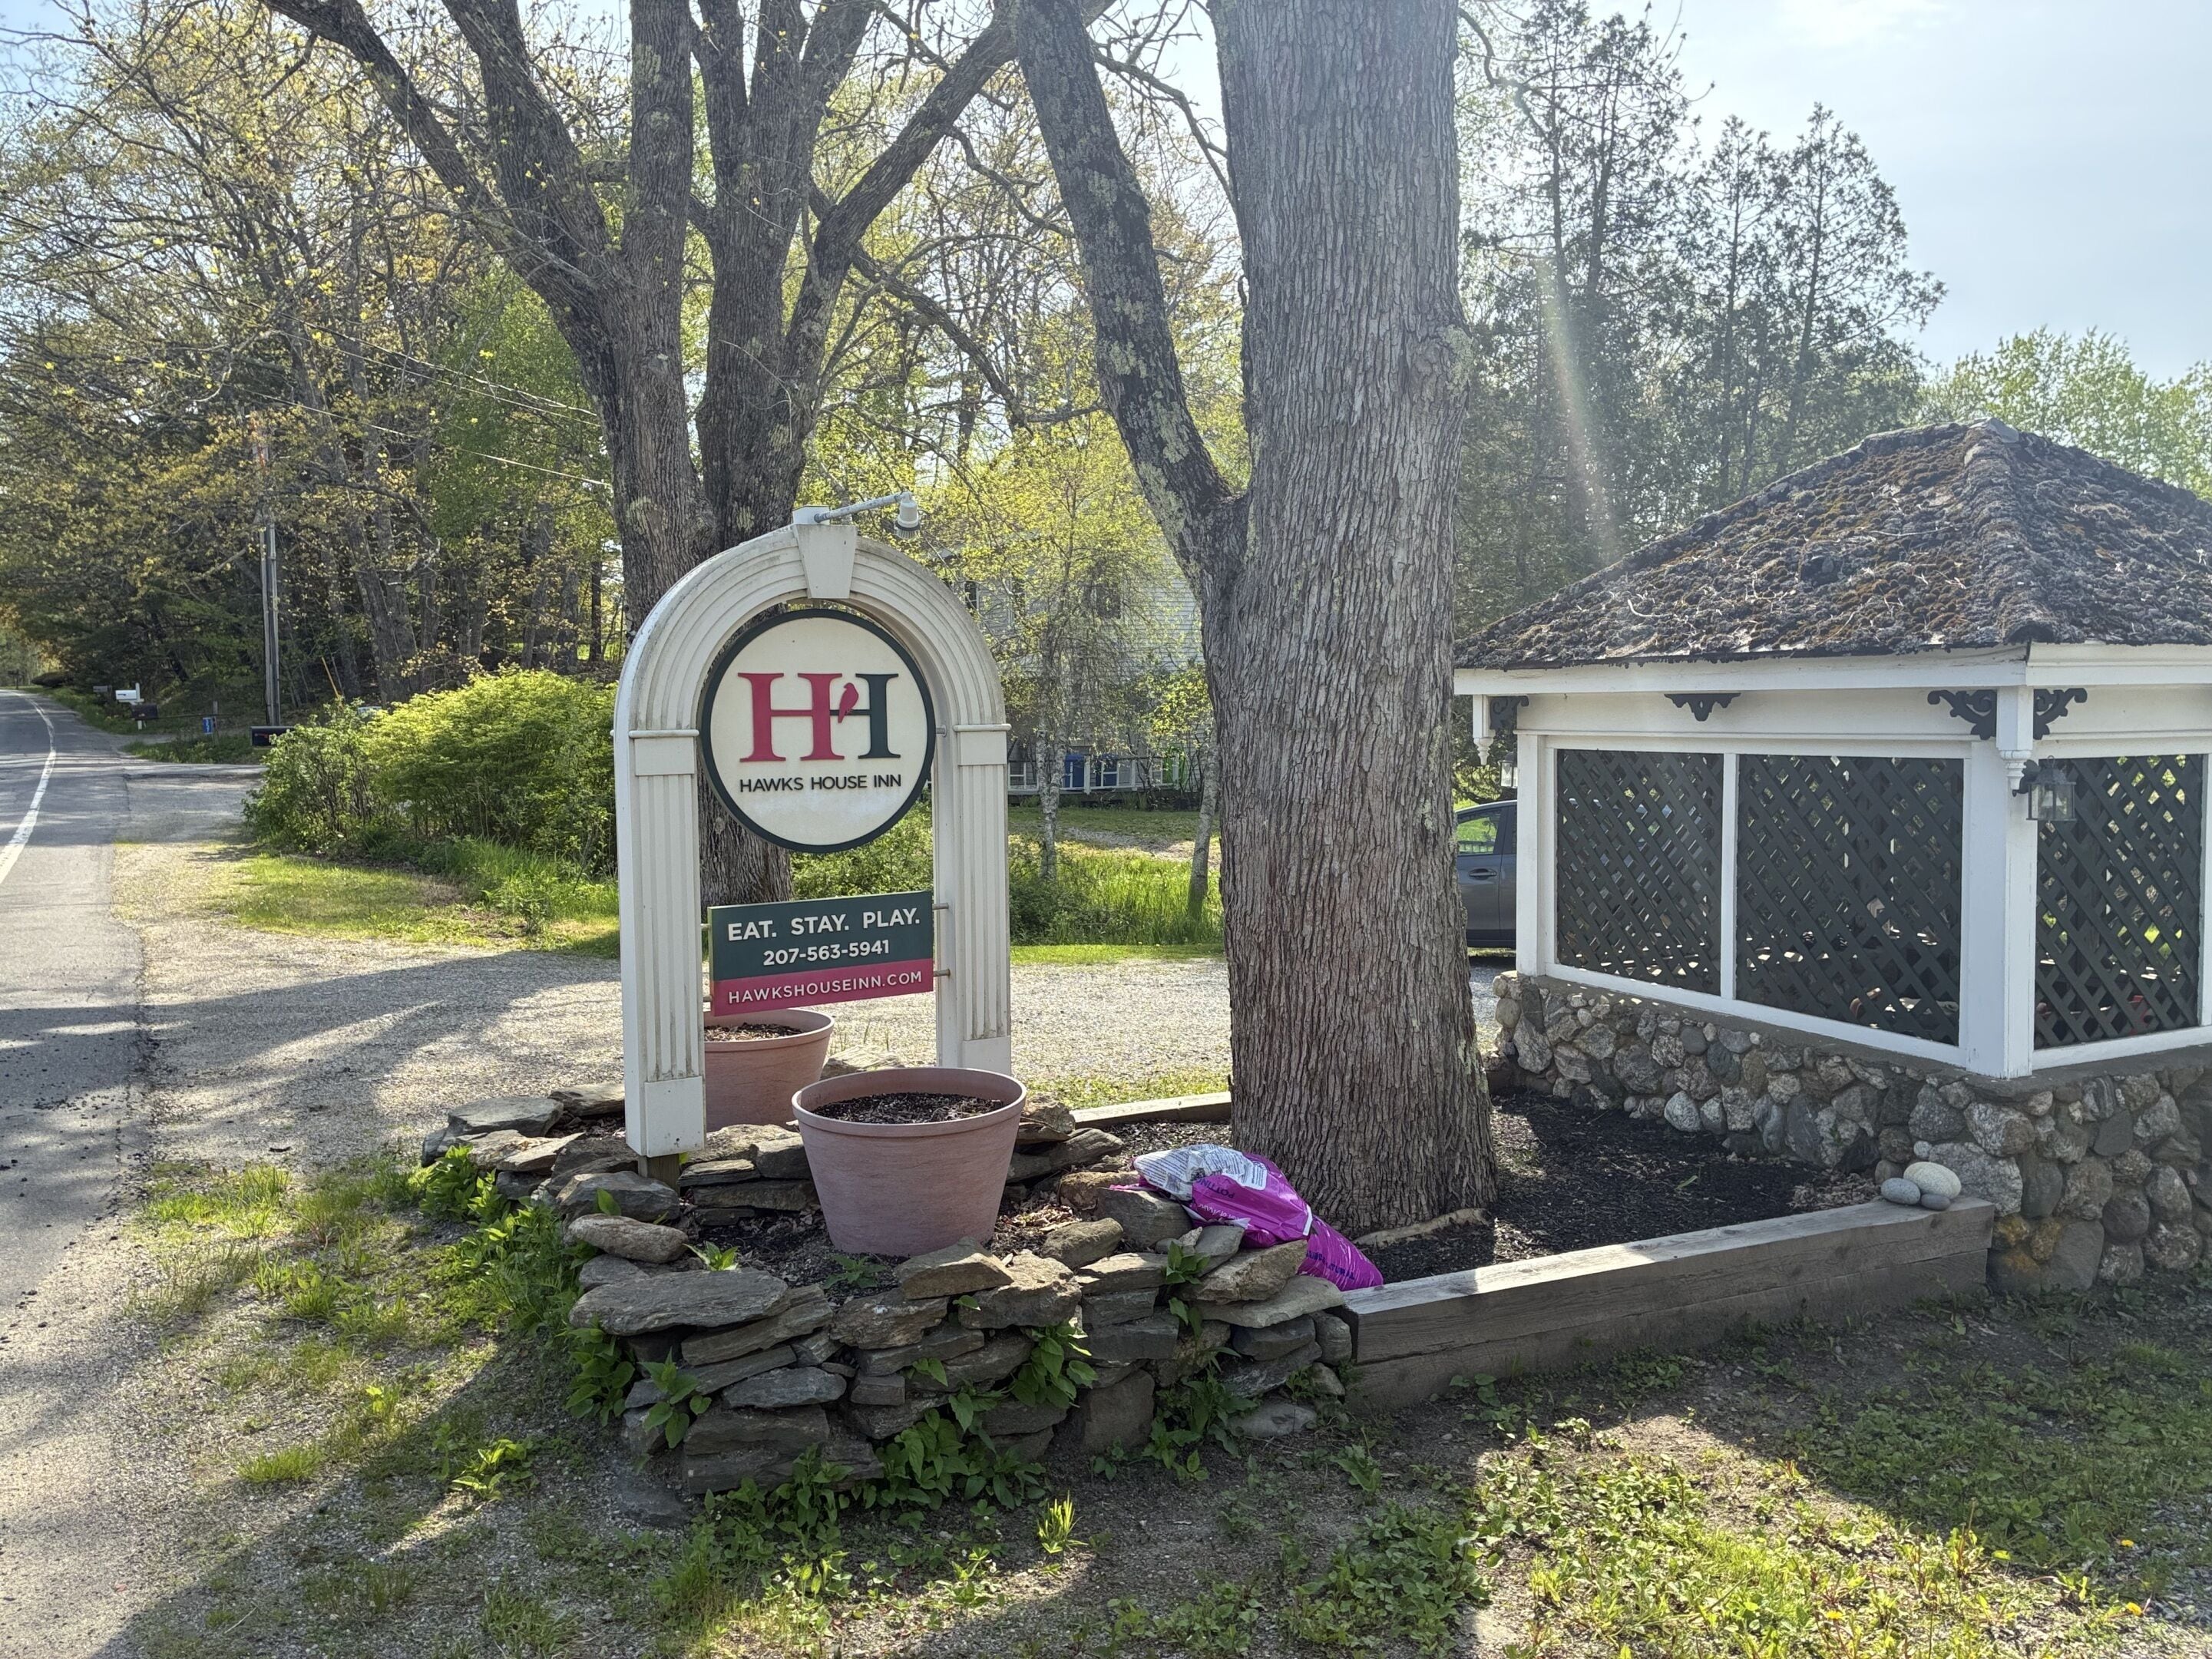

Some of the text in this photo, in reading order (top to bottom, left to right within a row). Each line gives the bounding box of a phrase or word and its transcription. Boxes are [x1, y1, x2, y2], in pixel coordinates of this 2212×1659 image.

[739, 774, 901, 792] HAWKS HOUSE INN
[728, 907, 921, 941] EAT. STAY. PLAY.
[762, 939, 890, 966] 207-563-5941
[729, 970, 922, 1004] HAWKSHOUSEINN.COM
